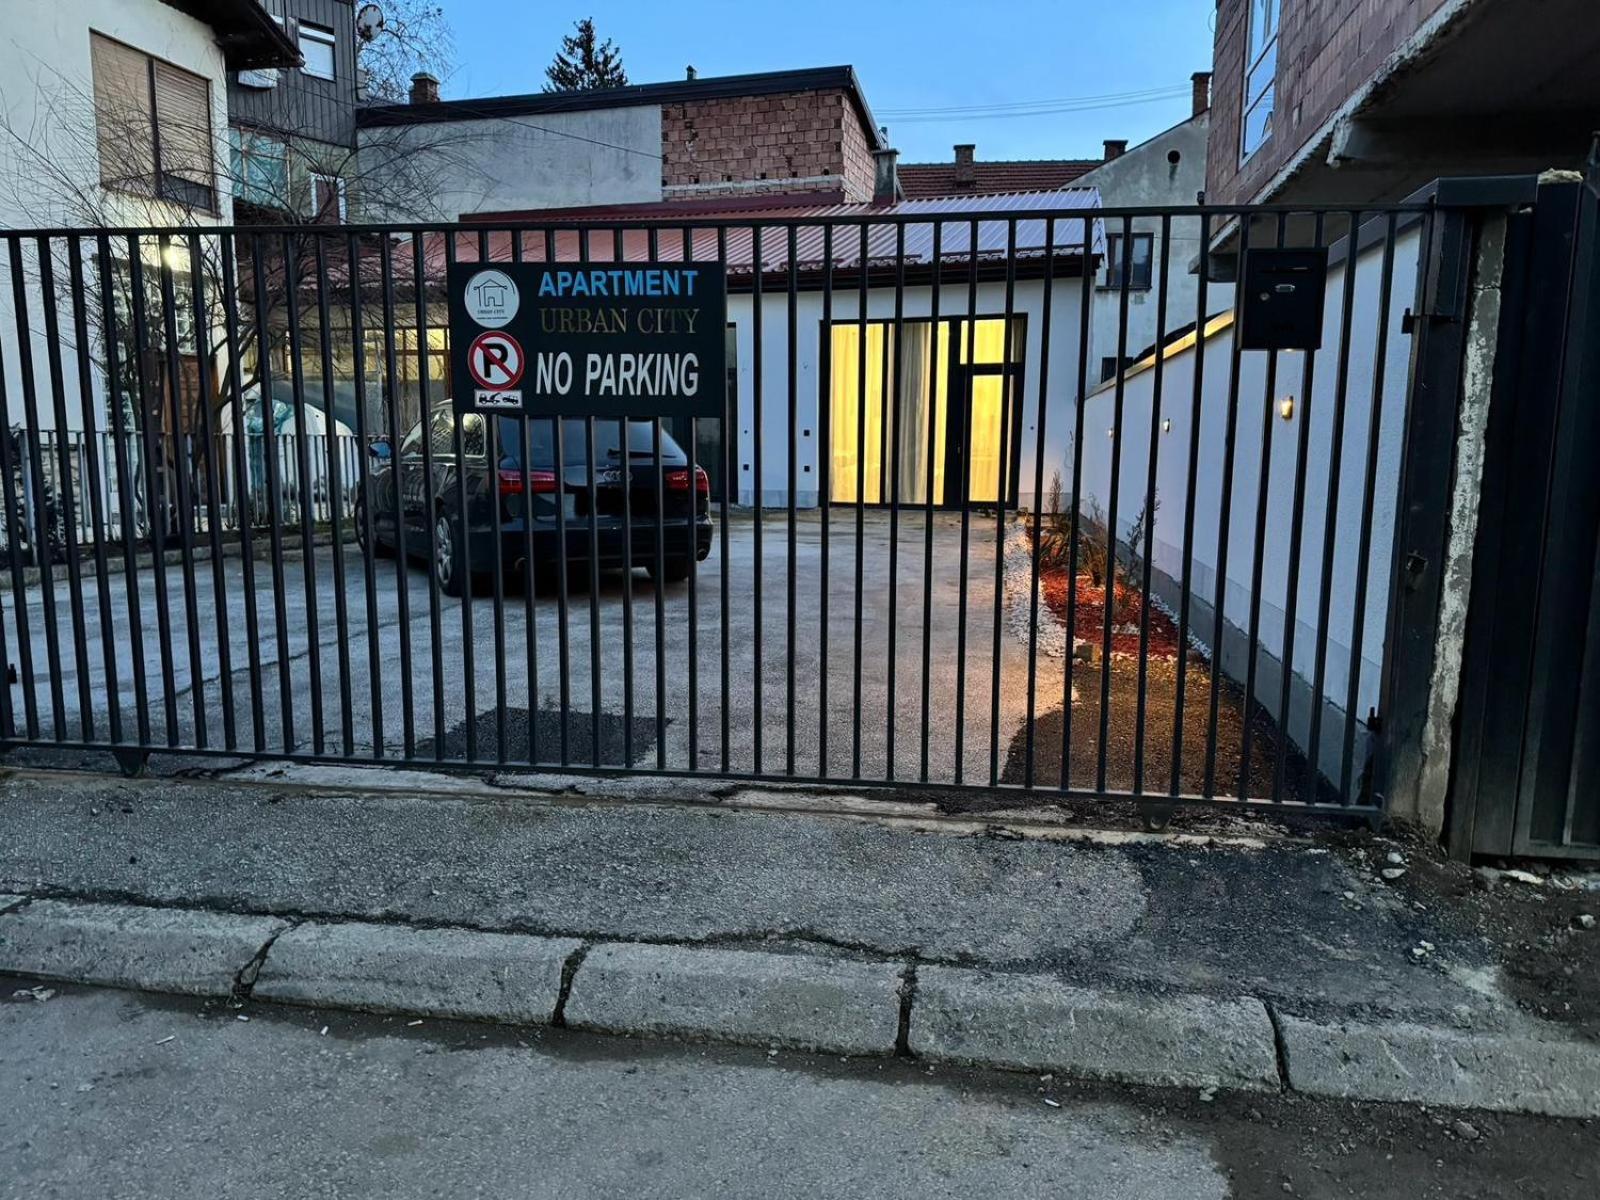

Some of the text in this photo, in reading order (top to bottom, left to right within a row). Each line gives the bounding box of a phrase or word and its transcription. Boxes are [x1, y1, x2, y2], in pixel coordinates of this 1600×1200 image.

[538, 270, 698, 297] APARTMENT
[540, 307, 700, 334] URBAN CITY
[536, 352, 699, 396] NO PARKING
